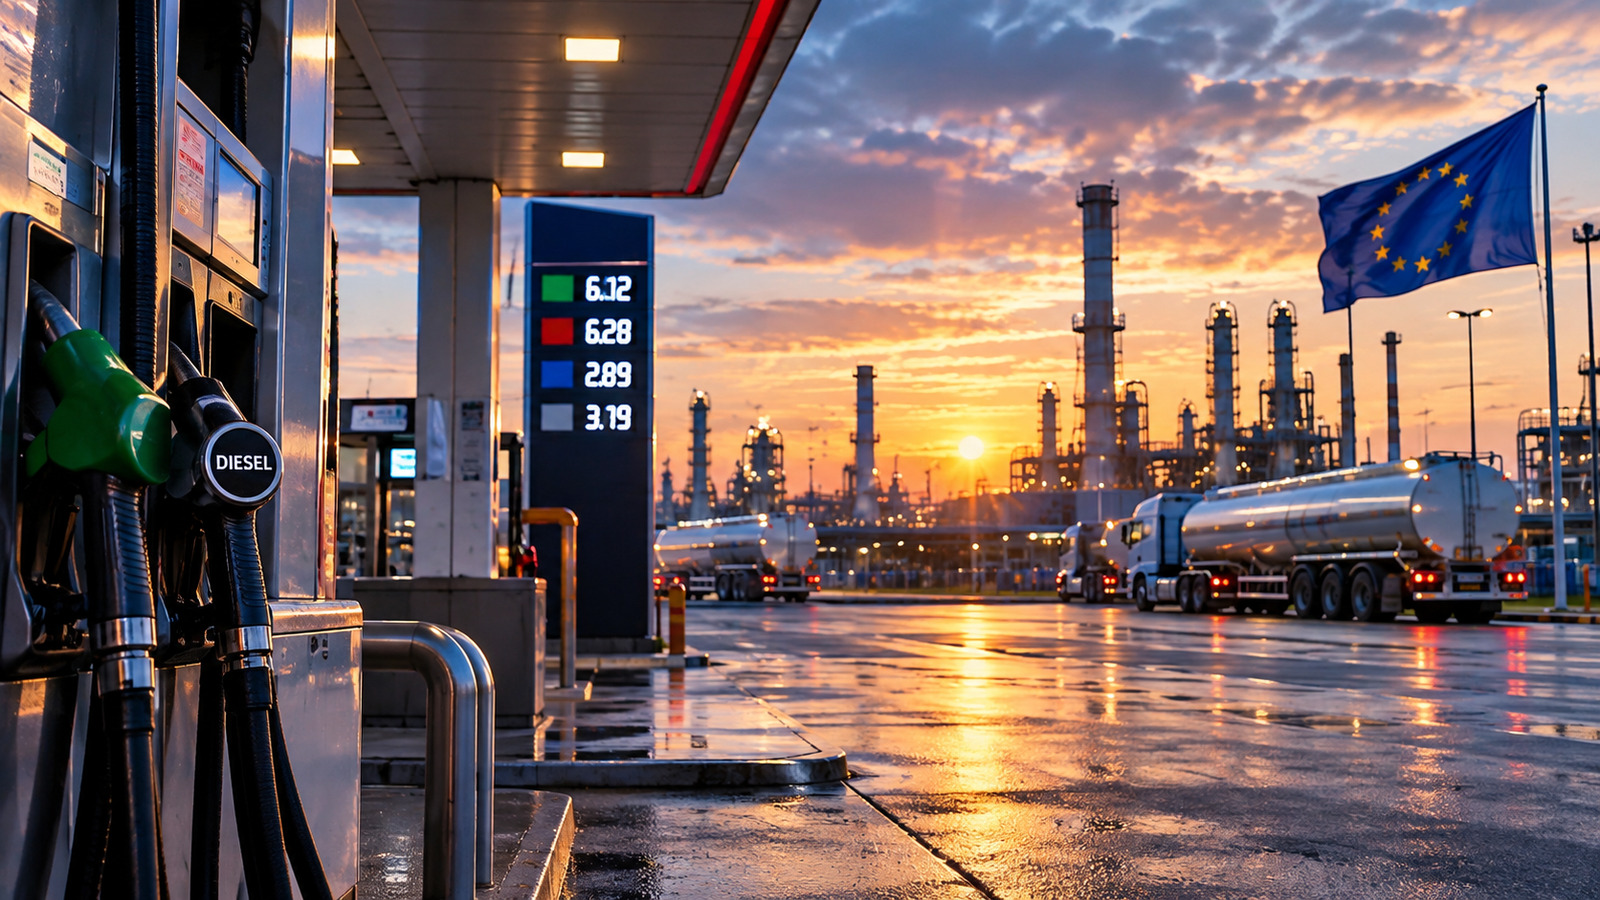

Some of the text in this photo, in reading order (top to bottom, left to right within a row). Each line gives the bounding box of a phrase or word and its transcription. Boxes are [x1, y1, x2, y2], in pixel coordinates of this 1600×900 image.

[585, 275, 632, 302] 6.12
[584, 318, 632, 345] 6.28
[584, 361, 632, 388] 2.89
[585, 404, 632, 431] 3.19
[216, 454, 273, 471] DIESEL
